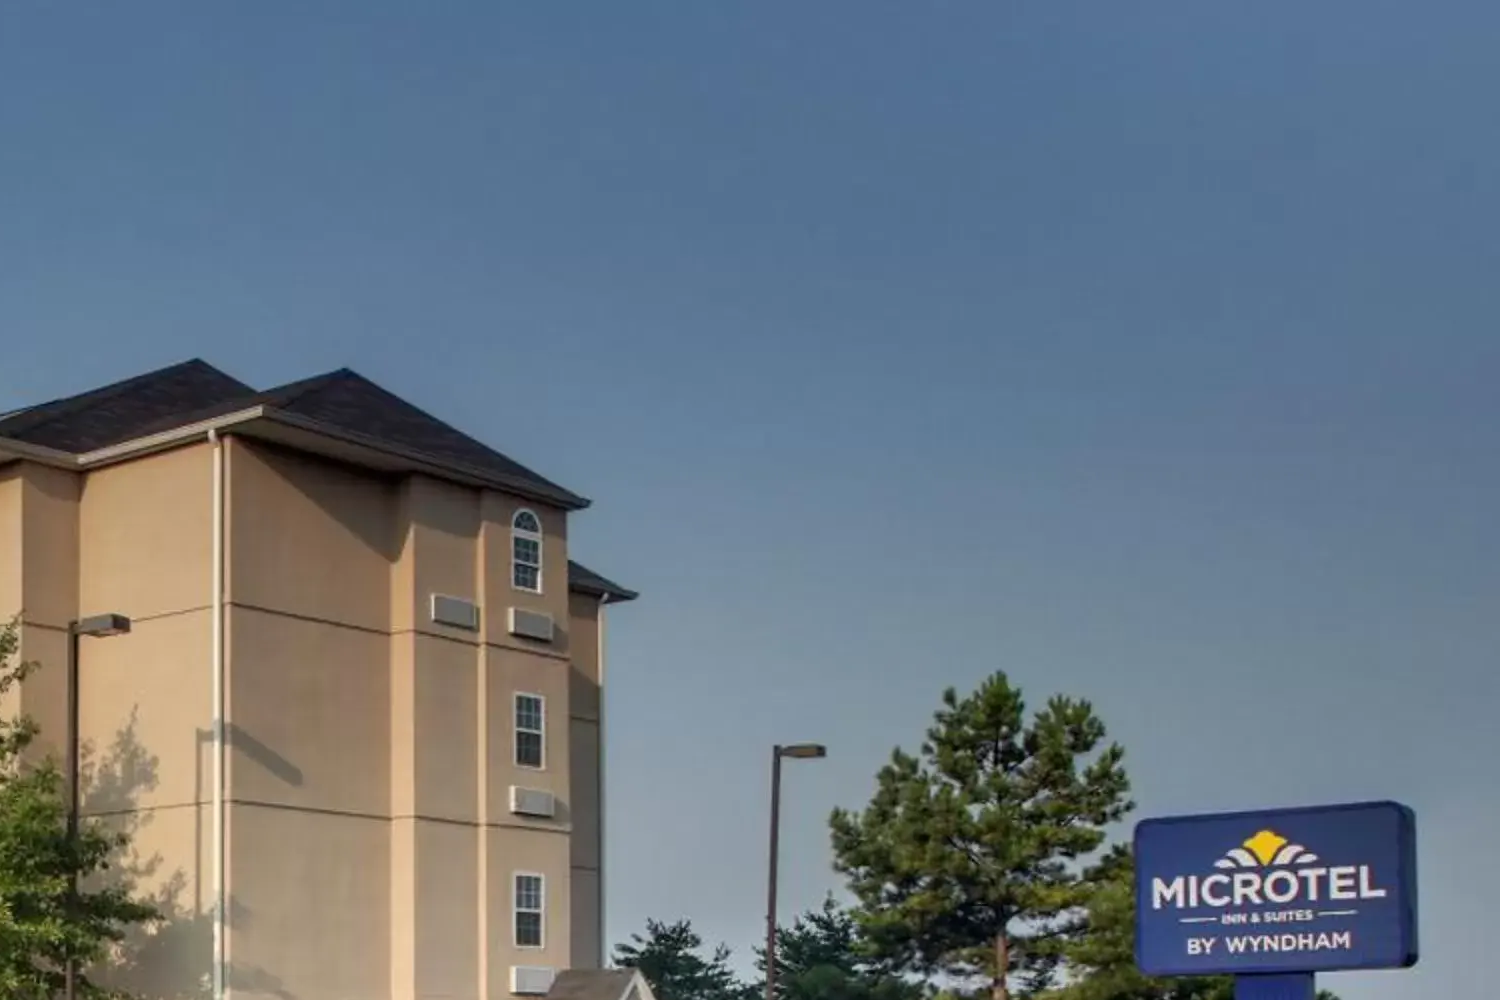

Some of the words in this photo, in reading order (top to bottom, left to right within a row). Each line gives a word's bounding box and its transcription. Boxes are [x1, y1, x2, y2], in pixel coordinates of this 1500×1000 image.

[1151, 865, 1387, 909] MICROTEL
[1221, 912, 1248, 925] INN
[1250, 912, 1261, 923] &
[1263, 909, 1314, 922] SUITES
[1187, 937, 1215, 955] BY
[1225, 931, 1351, 953] WYNDHAM
